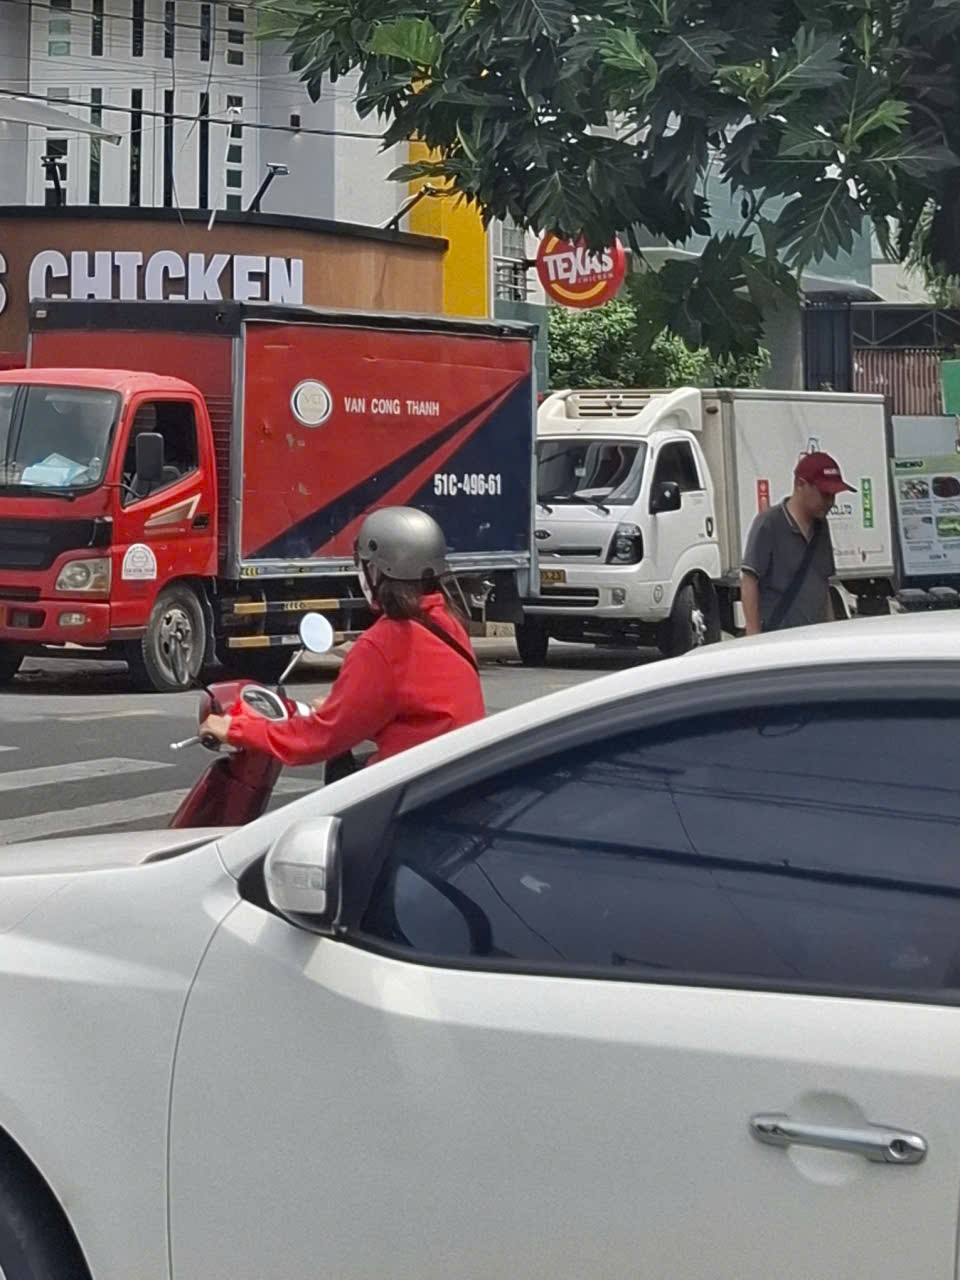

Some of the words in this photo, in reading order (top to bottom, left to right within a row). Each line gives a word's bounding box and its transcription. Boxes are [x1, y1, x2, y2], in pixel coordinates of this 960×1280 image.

[28, 250, 304, 305] CHICKEN
[344, 396, 366, 413] VAN
[371, 398, 401, 415] CONG
[406, 400, 440, 416] THANH
